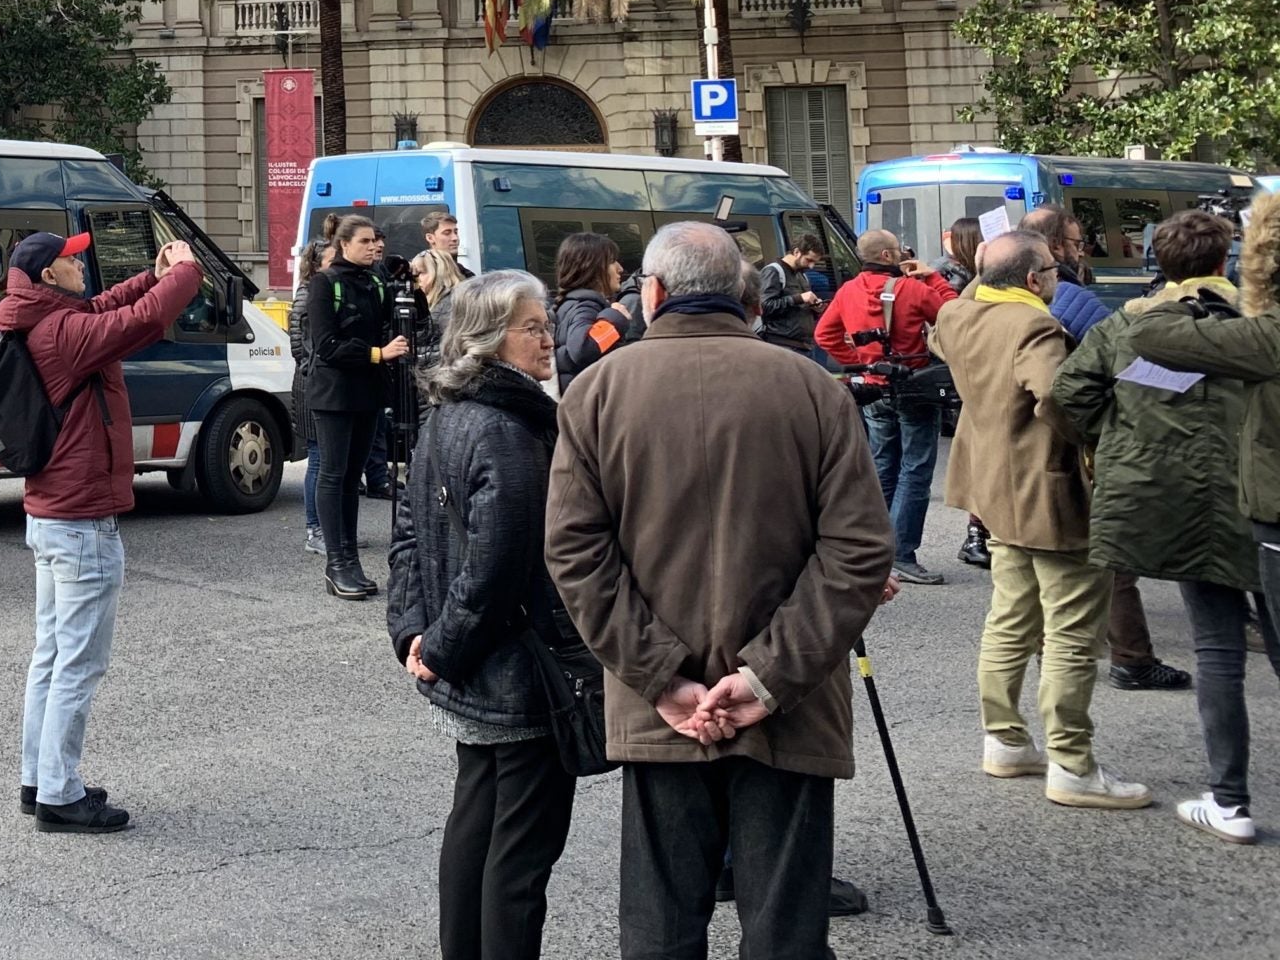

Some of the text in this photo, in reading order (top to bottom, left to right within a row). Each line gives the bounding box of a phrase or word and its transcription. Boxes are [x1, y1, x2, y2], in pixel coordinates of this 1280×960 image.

[700, 84, 728, 117] P
[381, 193, 444, 204] www.mossos.cat
[249, 347, 274, 358] policia
[940, 389, 946, 397] 8
